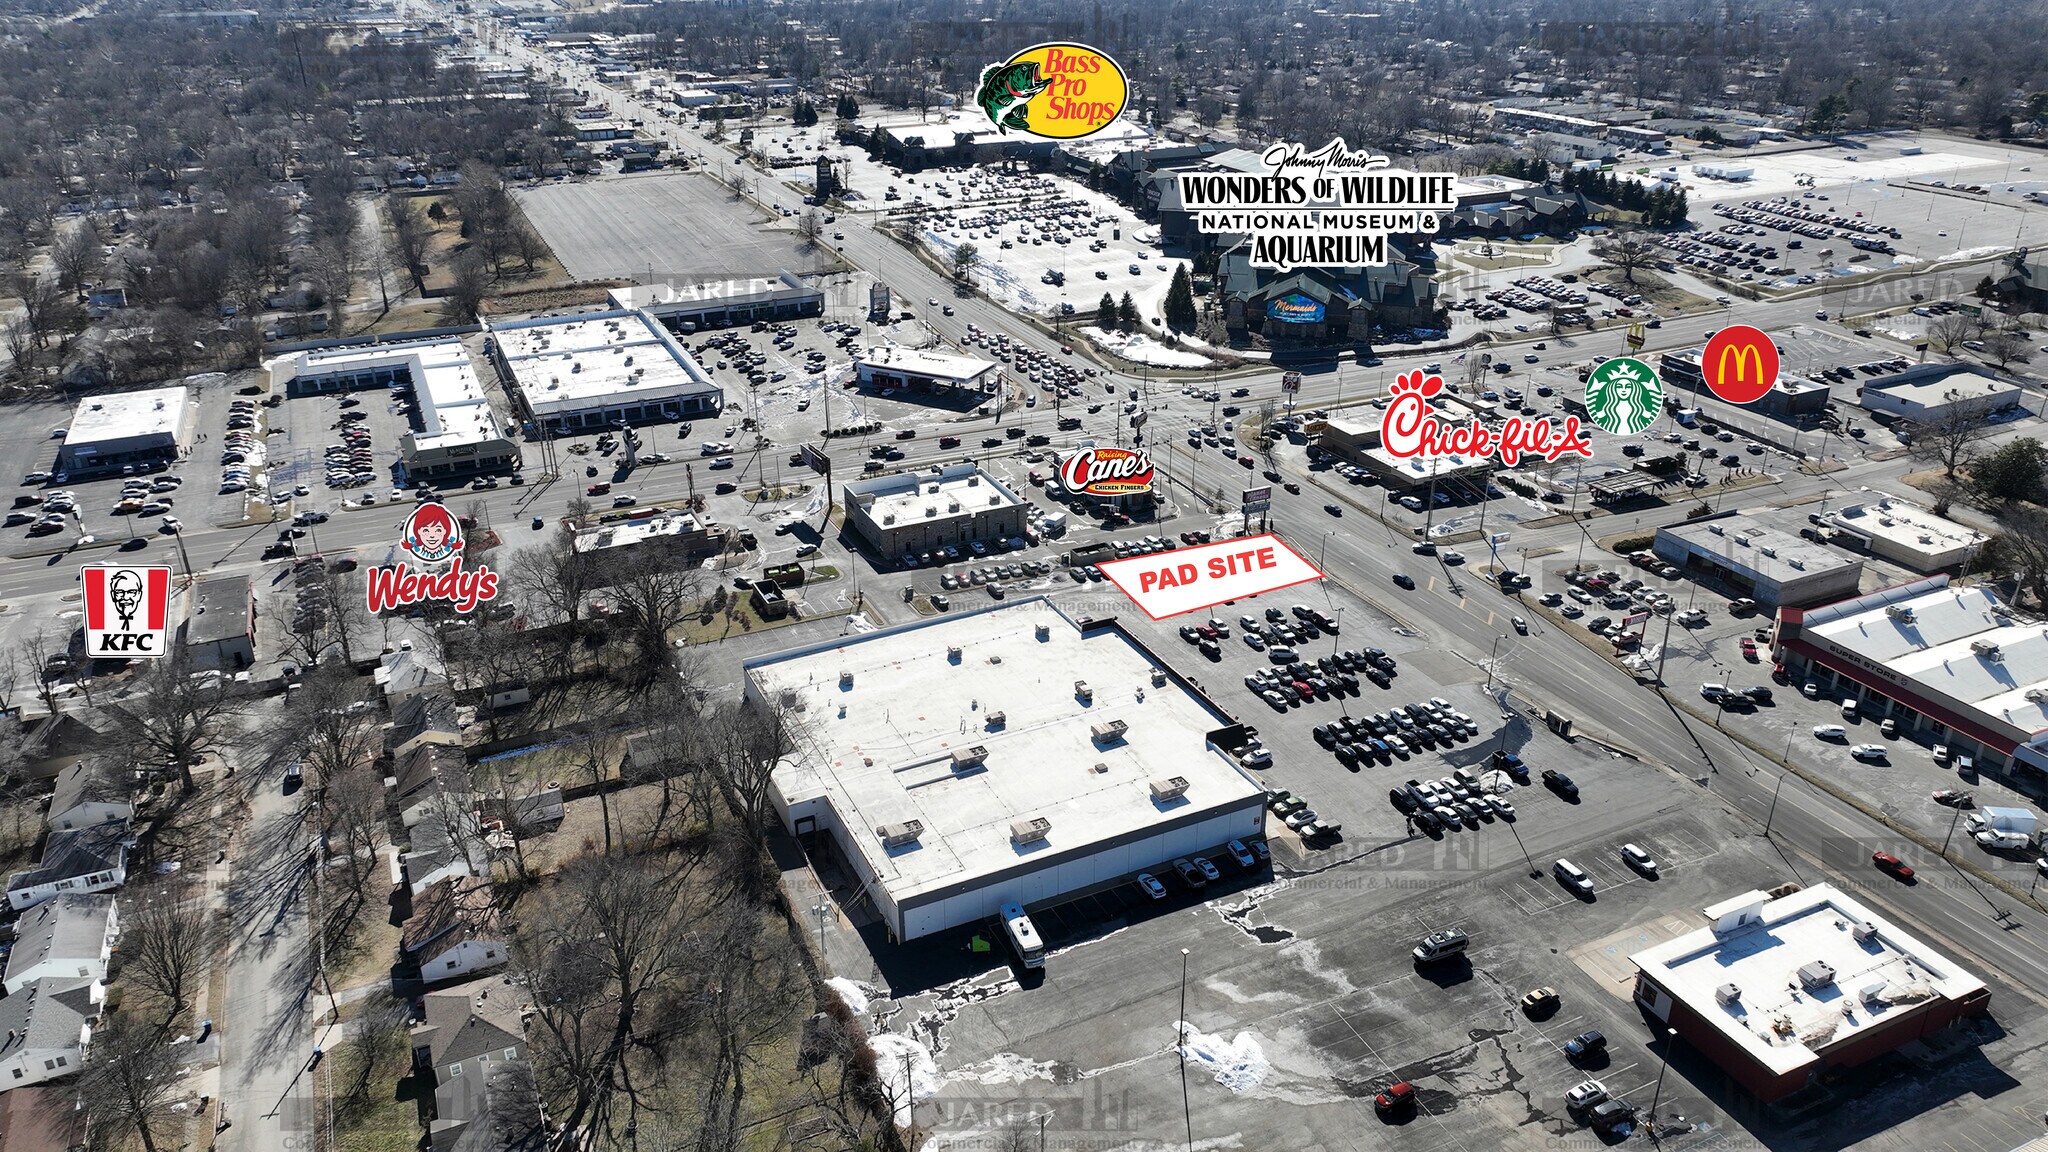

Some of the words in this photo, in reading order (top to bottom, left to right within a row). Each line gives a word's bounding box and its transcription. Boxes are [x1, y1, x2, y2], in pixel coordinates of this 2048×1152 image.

[1274, 299, 1317, 312] Mermaids
[1829, 645, 1861, 664] SUPER
[1864, 661, 1898, 681] STORE
